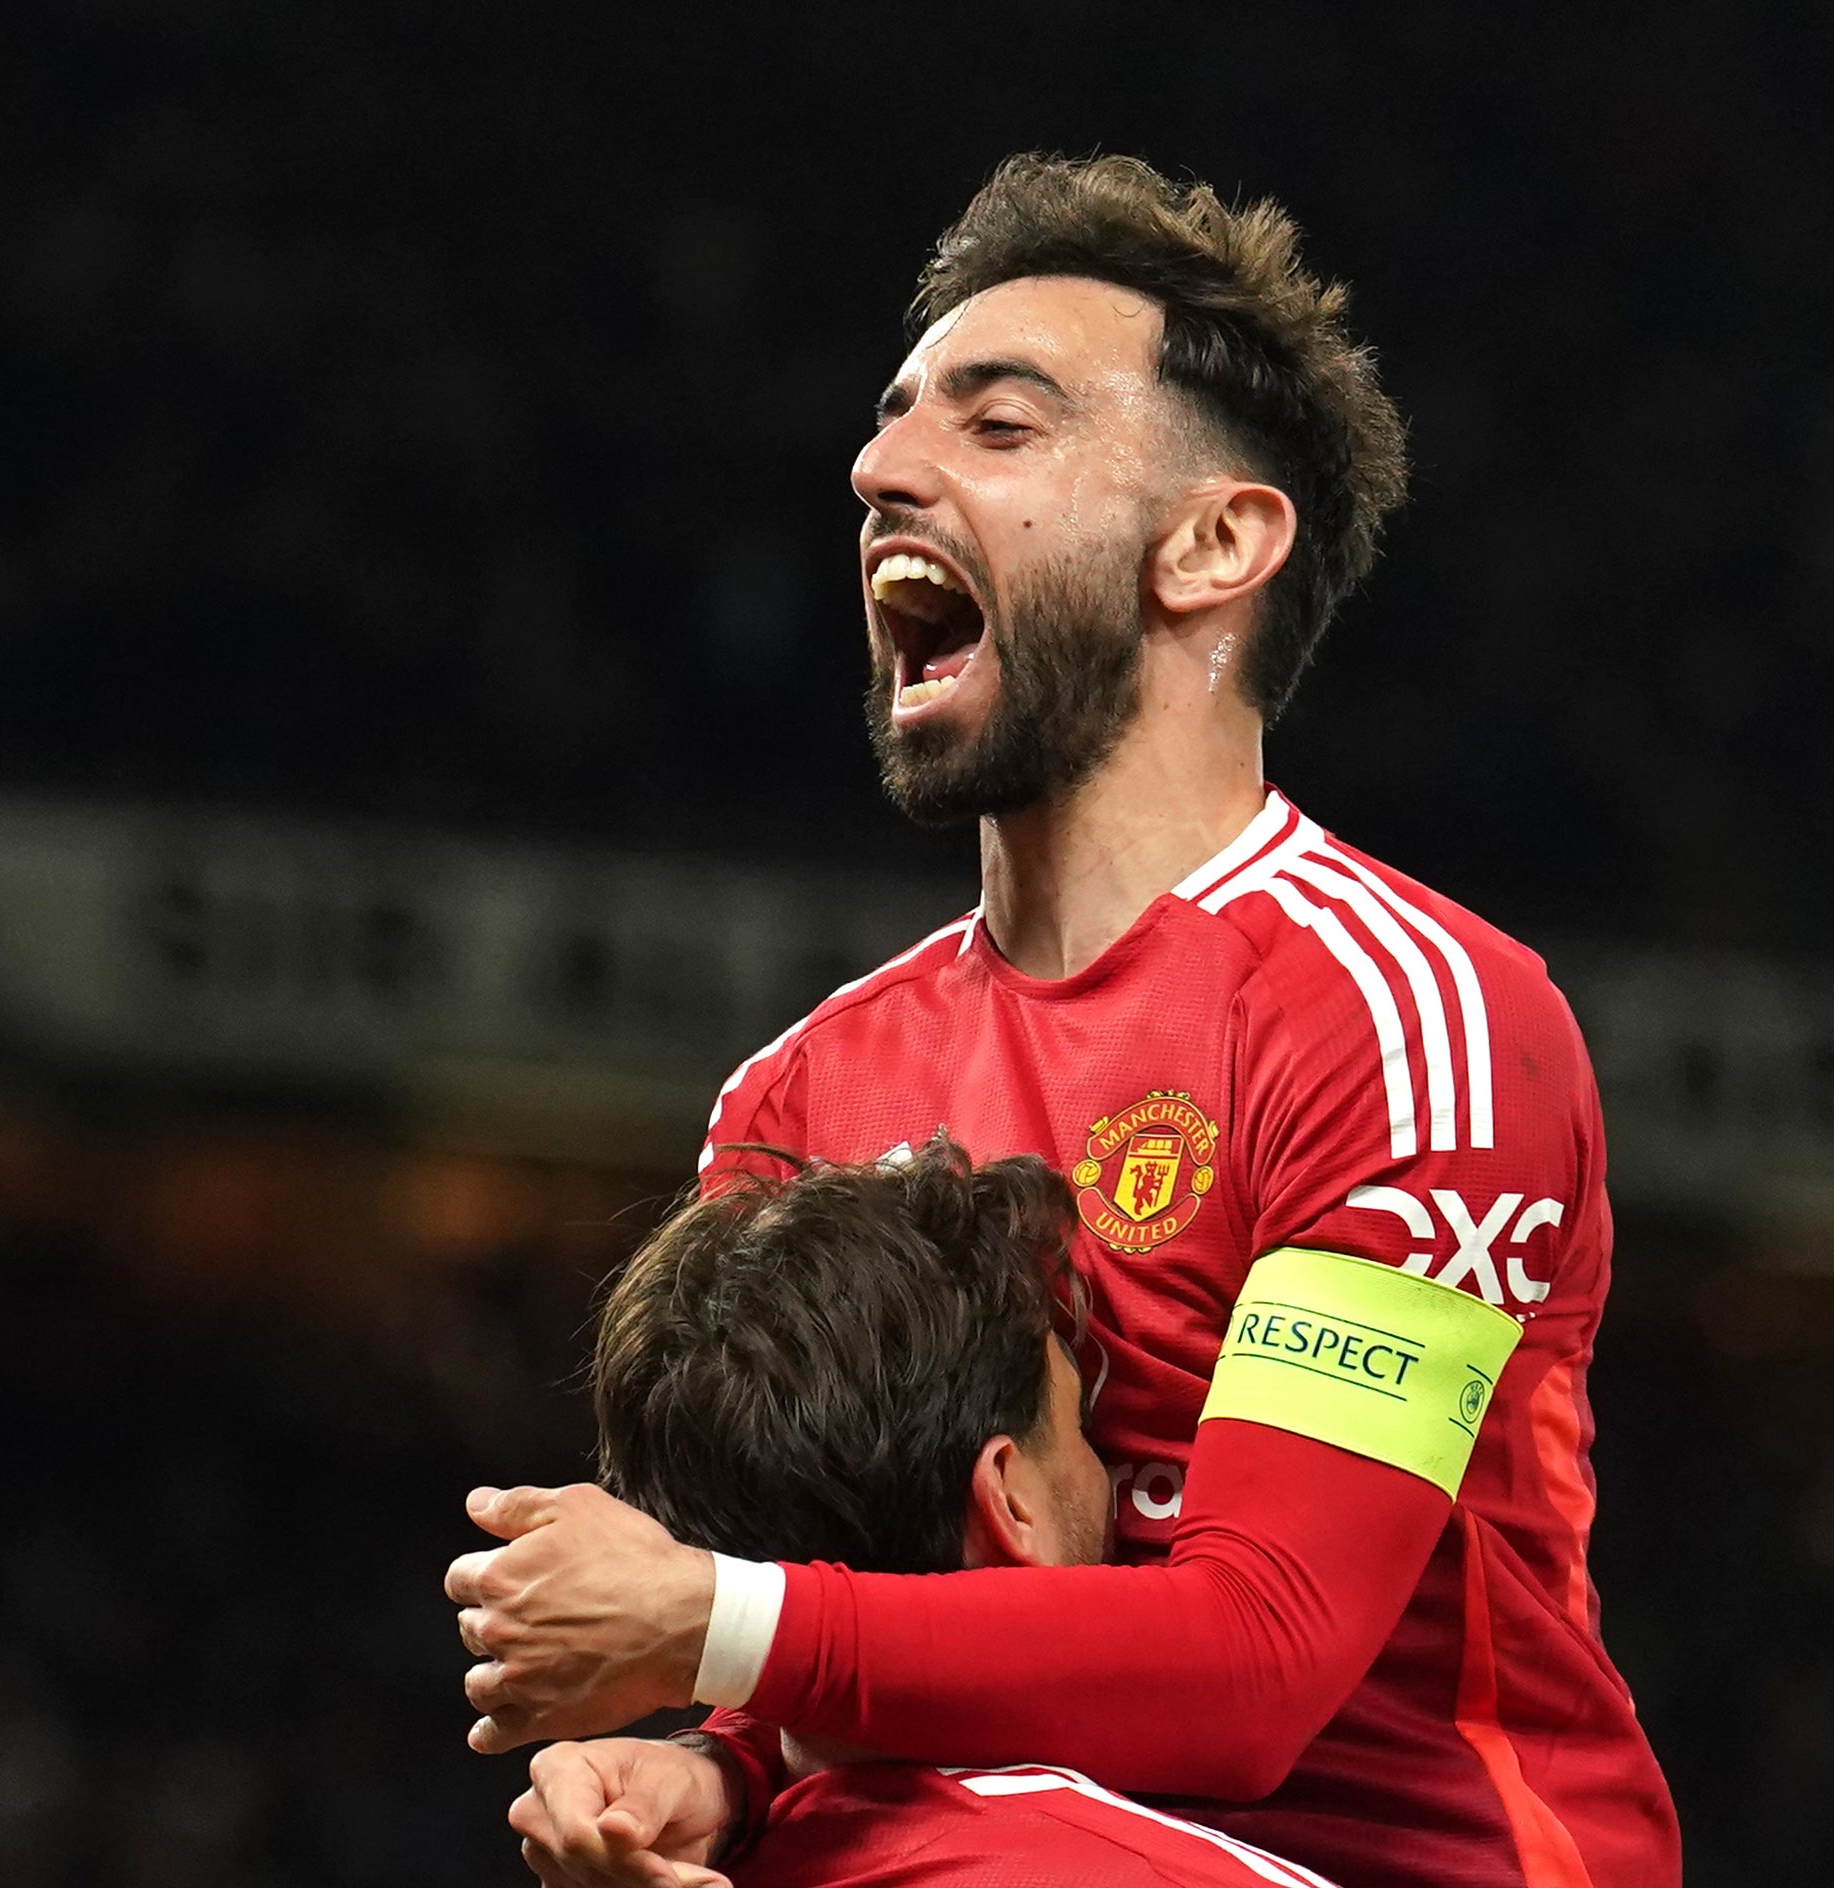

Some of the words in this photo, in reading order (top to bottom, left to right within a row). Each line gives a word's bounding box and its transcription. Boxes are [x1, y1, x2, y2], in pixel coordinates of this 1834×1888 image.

[1099, 1104, 1209, 1155] MANCHESTER
[1096, 1212, 1177, 1242] UNITED
[1237, 1313, 1420, 1386] RESPECT
